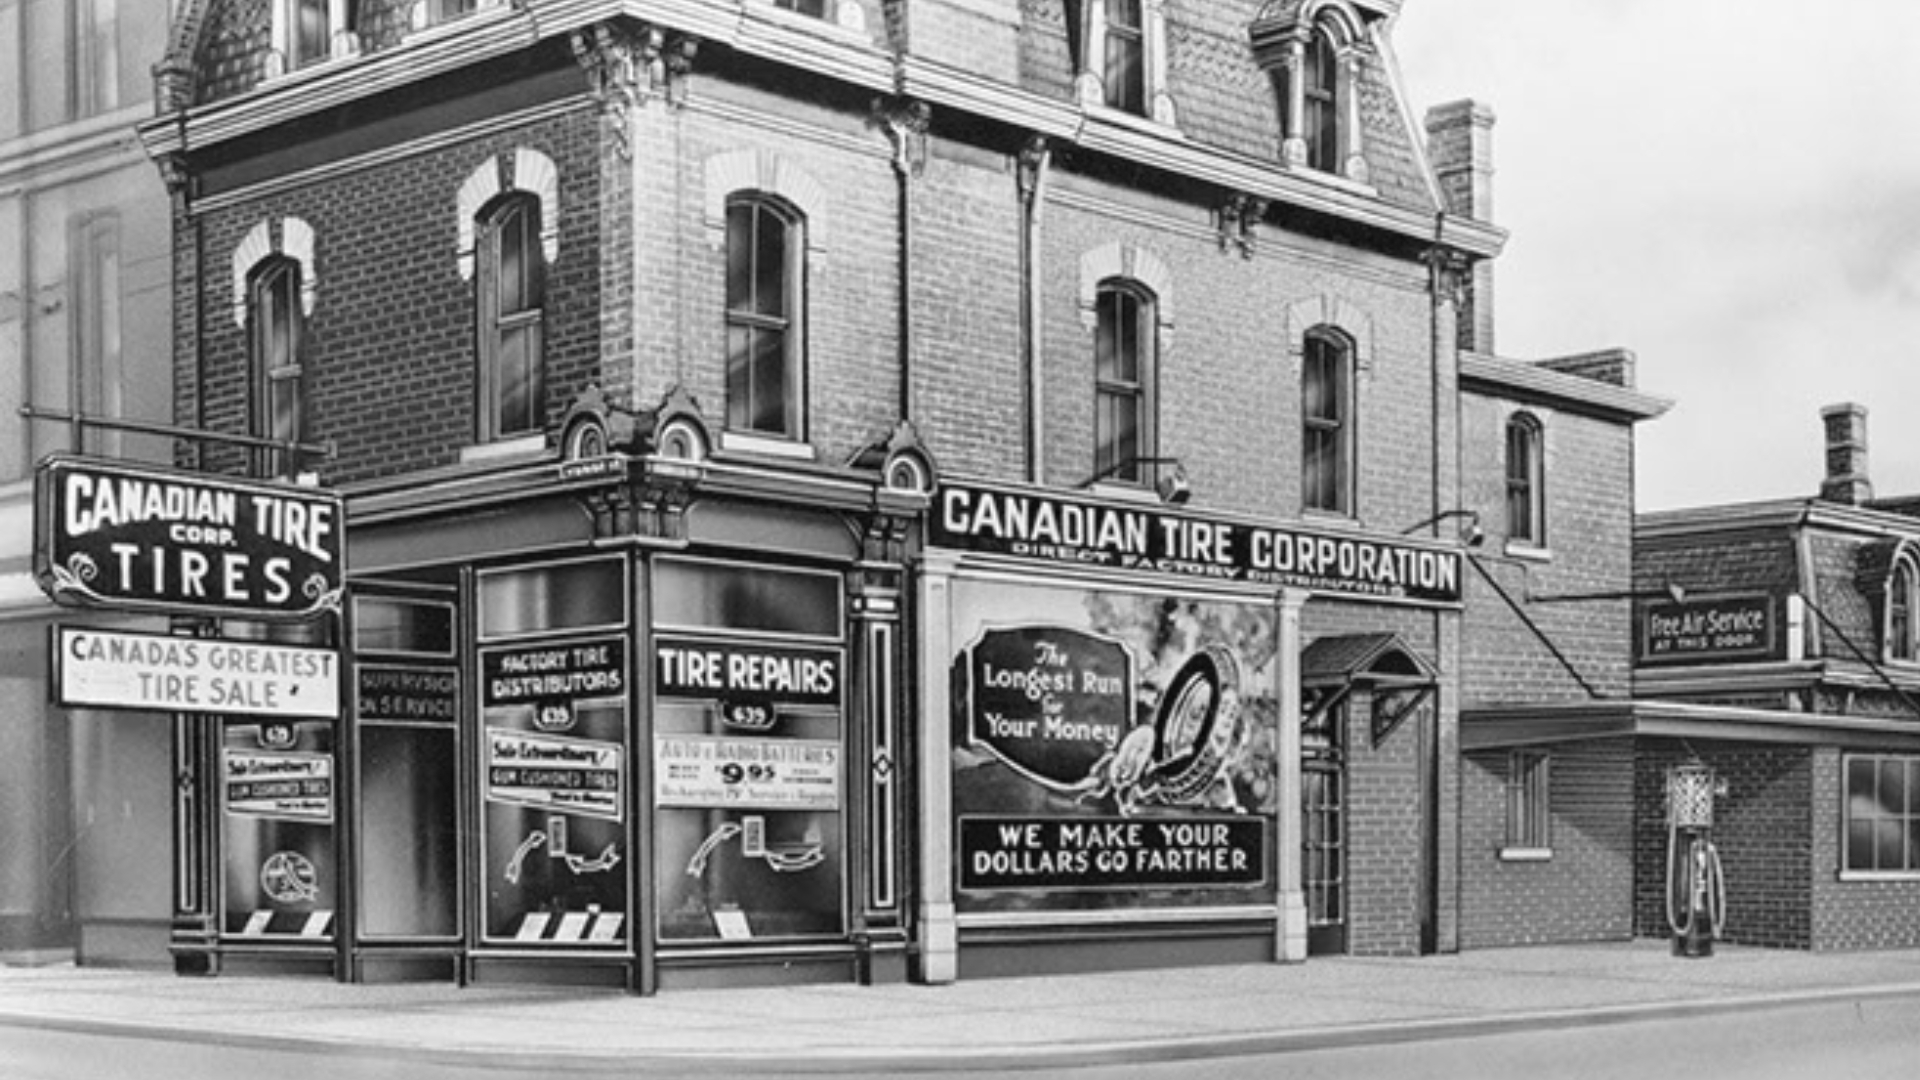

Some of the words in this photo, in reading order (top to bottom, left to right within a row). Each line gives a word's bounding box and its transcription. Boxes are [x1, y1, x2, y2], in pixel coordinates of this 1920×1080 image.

[65, 473, 235, 536] CANADIAN
[252, 497, 332, 562] TIRE
[169, 524, 238, 546] CORP.
[944, 489, 1148, 554] CANADIAN
[1160, 517, 1233, 565] TIRE
[1251, 530, 1456, 591] CORPORATION
[110, 543, 292, 602] TIRES
[1012, 542, 1113, 563] DIRECT
[1121, 553, 1241, 578] FACTORY
[1651, 613, 1681, 636] Free
[1681, 611, 1705, 634] Air
[1707, 607, 1763, 634] Service
[70, 635, 199, 669] CANADA'S
[208, 646, 332, 679] GREATEST
[502, 650, 568, 673] FACTORY
[574, 645, 610, 667] TIRE
[658, 648, 722, 687] TIRE
[728, 653, 834, 694] REPAIRS
[1034, 641, 1068, 666] The
[139, 672, 199, 702] TIRE
[210, 677, 279, 707] SALE
[492, 669, 621, 699] DISTRIBUTORS
[983, 663, 1074, 700] Longest
[1082, 670, 1123, 694] Run
[984, 712, 1038, 738] Your
[1043, 715, 1120, 750] Money
[999, 823, 1042, 848] WE
[1060, 824, 1143, 848] MAKE
[1159, 823, 1229, 847] YOUR
[974, 850, 1090, 875] DOLLARS
[1095, 850, 1129, 872] GO
[1136, 849, 1249, 872] FARTHER
